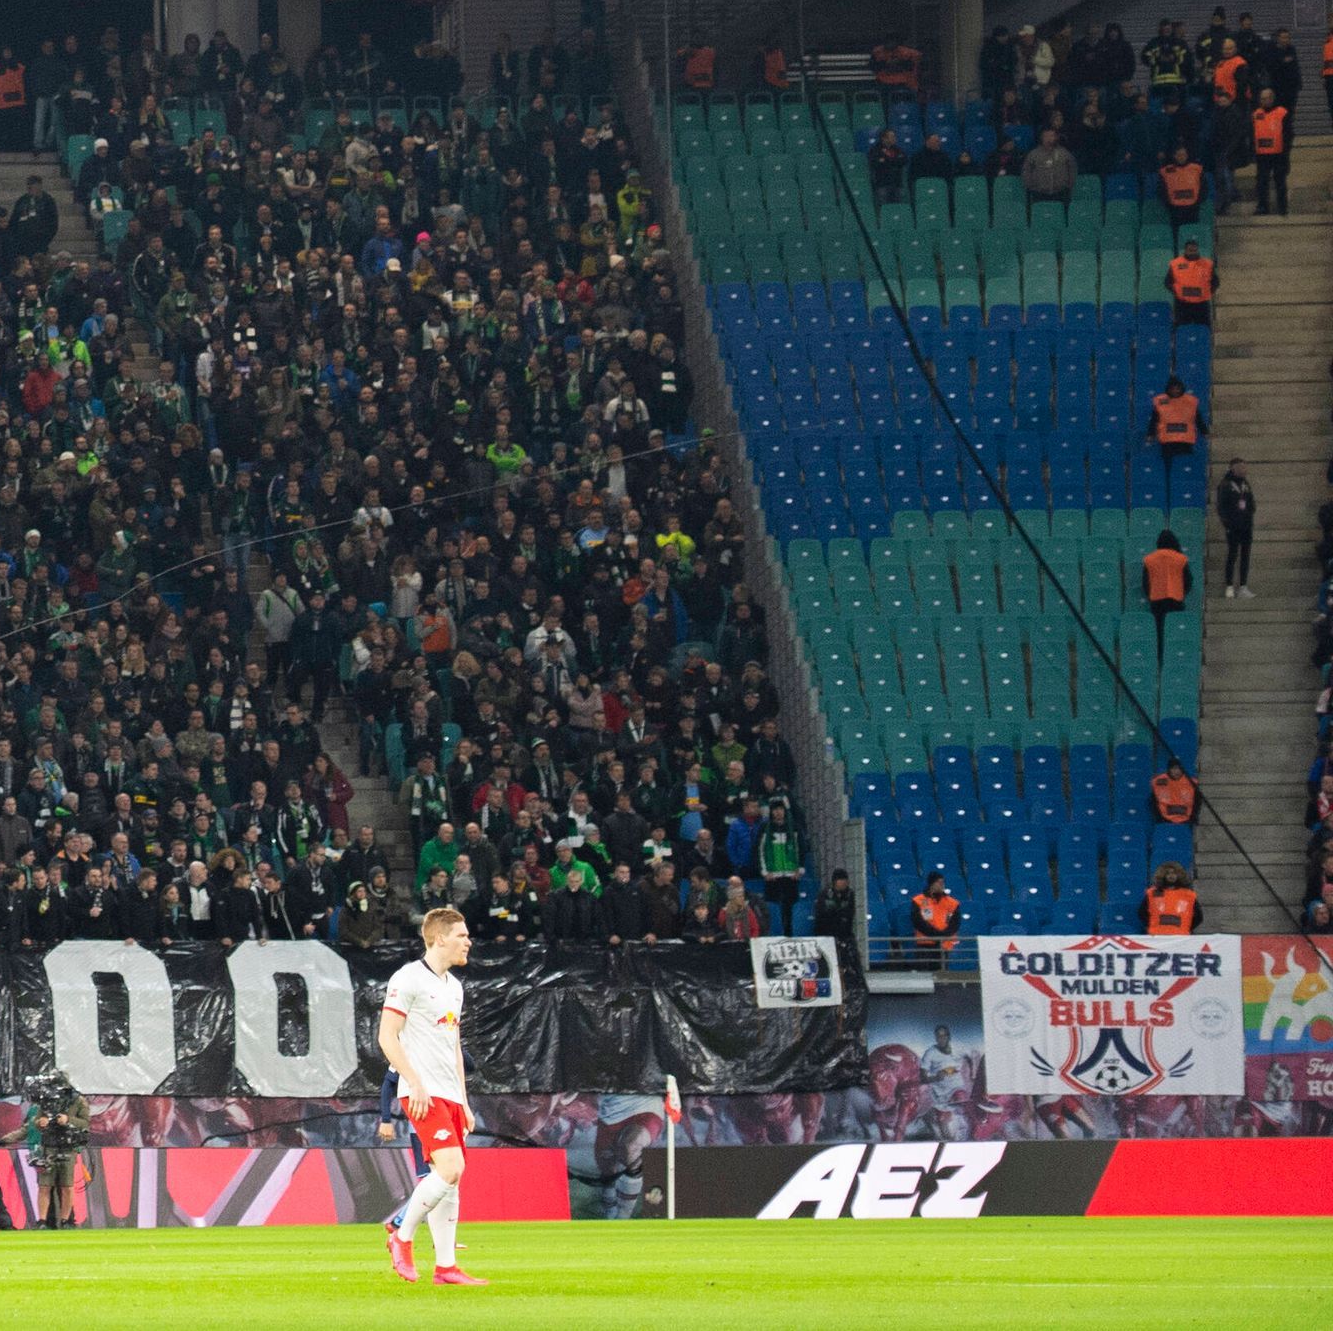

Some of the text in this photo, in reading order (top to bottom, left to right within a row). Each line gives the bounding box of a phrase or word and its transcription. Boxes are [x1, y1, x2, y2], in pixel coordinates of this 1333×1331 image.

[767, 940, 821, 962] NEIN
[999, 952, 1222, 977] COLDITZER
[769, 979, 795, 998] ZU
[1061, 978, 1160, 996] MULDEN
[1049, 1000, 1175, 1027] BULLS
[756, 1140, 1008, 1219] AEZ
